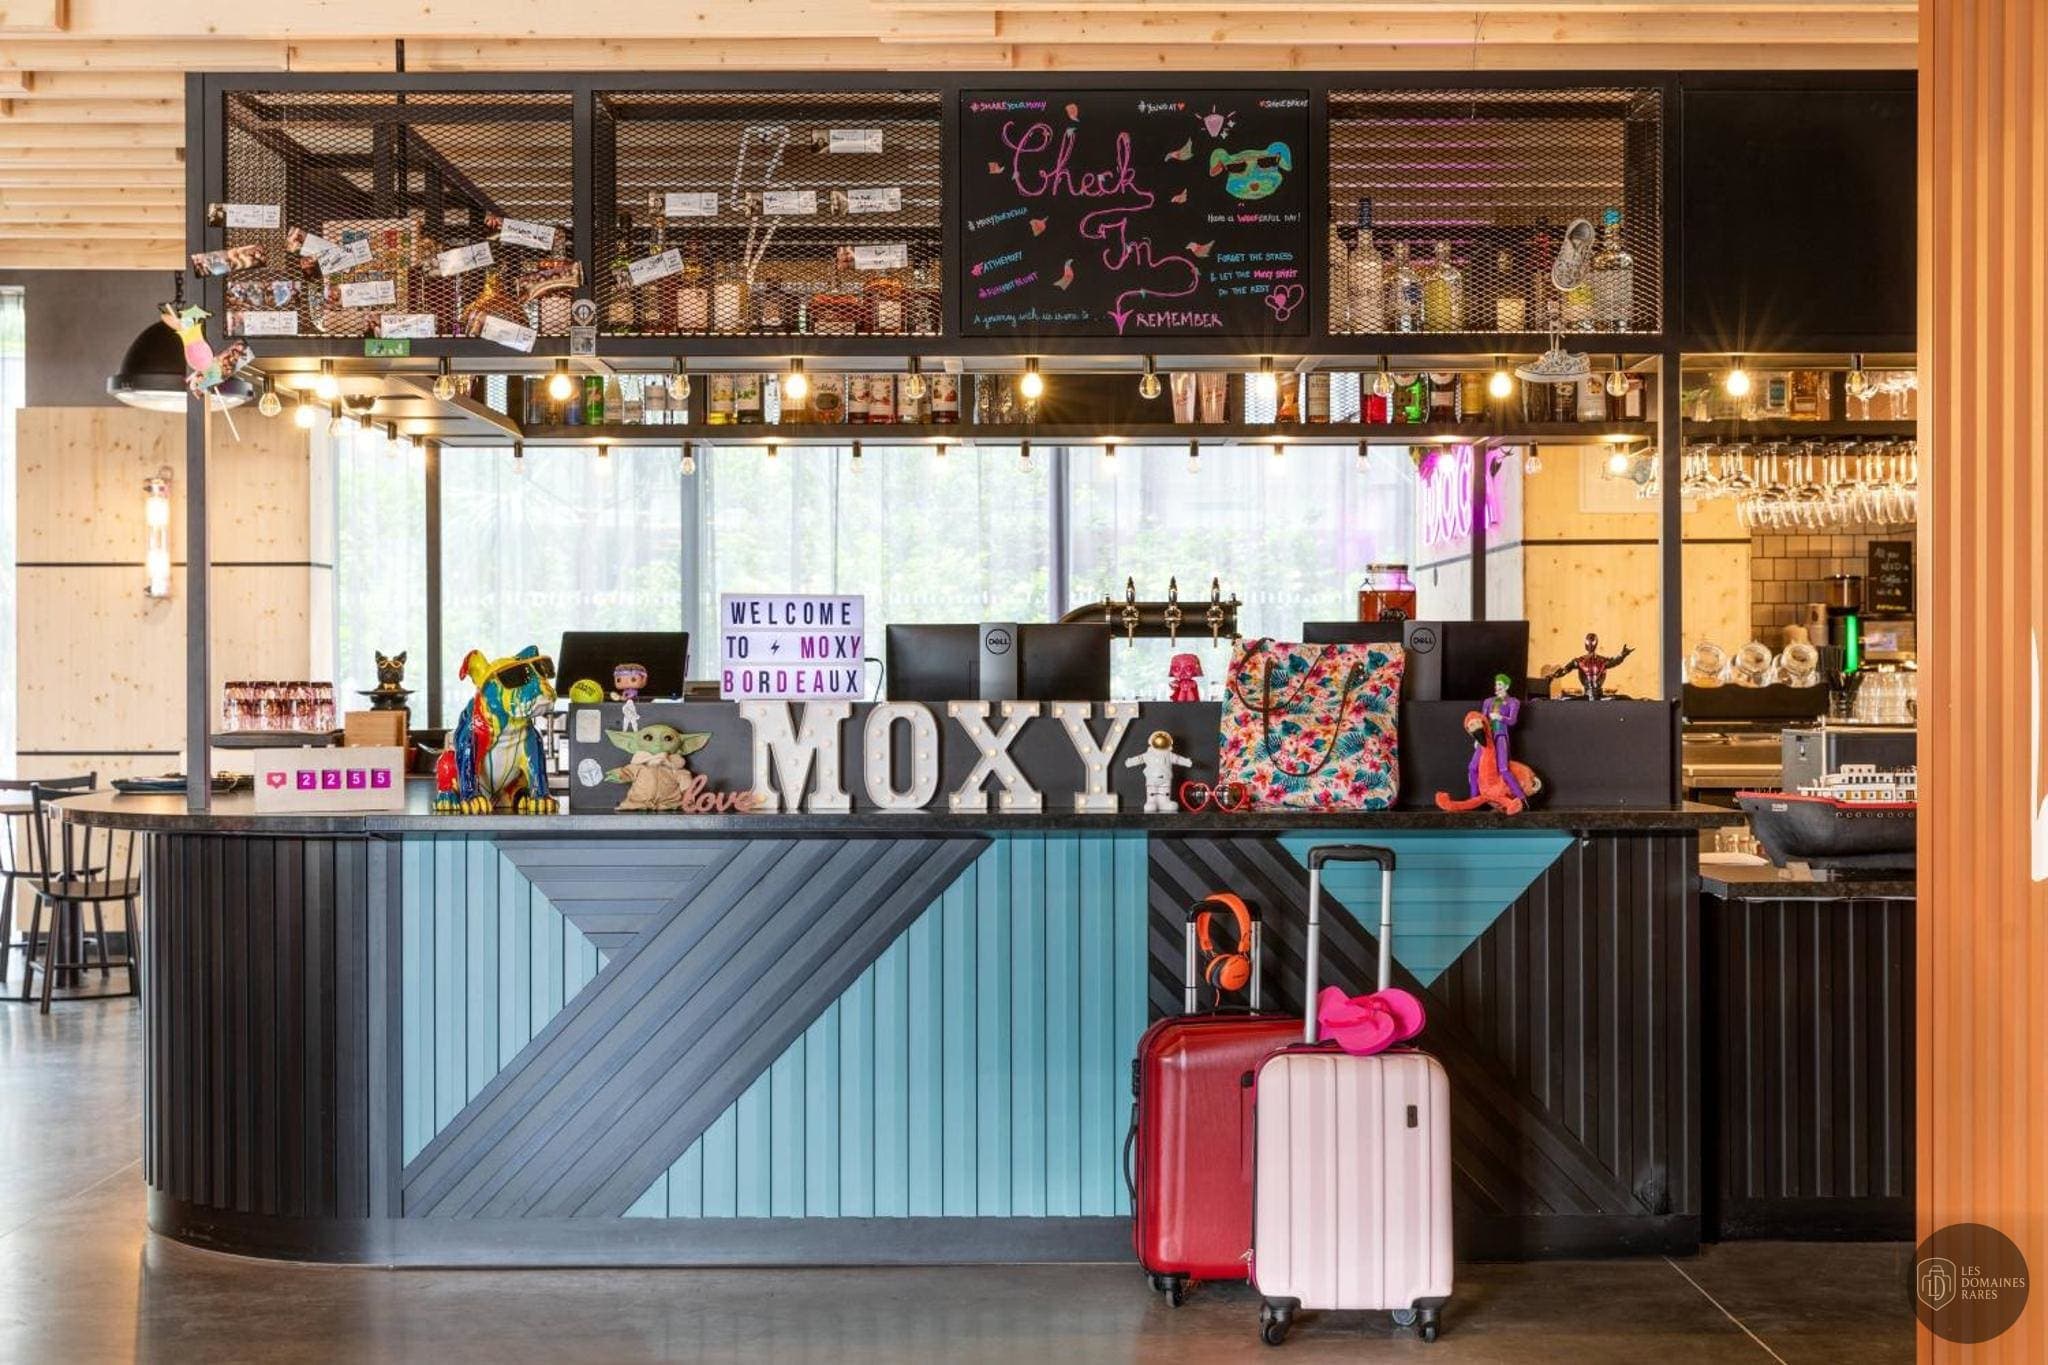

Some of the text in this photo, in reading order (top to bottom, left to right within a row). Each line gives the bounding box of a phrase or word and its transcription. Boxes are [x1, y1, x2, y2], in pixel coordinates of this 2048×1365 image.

[1003, 120, 1147, 196] Check
[1217, 251, 1293, 263] FORGET THE STRESS
[1219, 272, 1233, 281] LET
[1235, 270, 1251, 279] THE
[1231, 285, 1248, 295] THE
[1250, 284, 1271, 294] REST
[1136, 311, 1223, 328] REMEMBER
[731, 602, 851, 625] WELCOME
[726, 636, 861, 659] TO MOXY
[988, 637, 1008, 646] DELL
[1413, 636, 1433, 645] DELL
[723, 670, 858, 693] BORDEAUX
[740, 700, 1139, 812] MOXY
[300, 771, 387, 788] 2255
[681, 774, 764, 812] love
